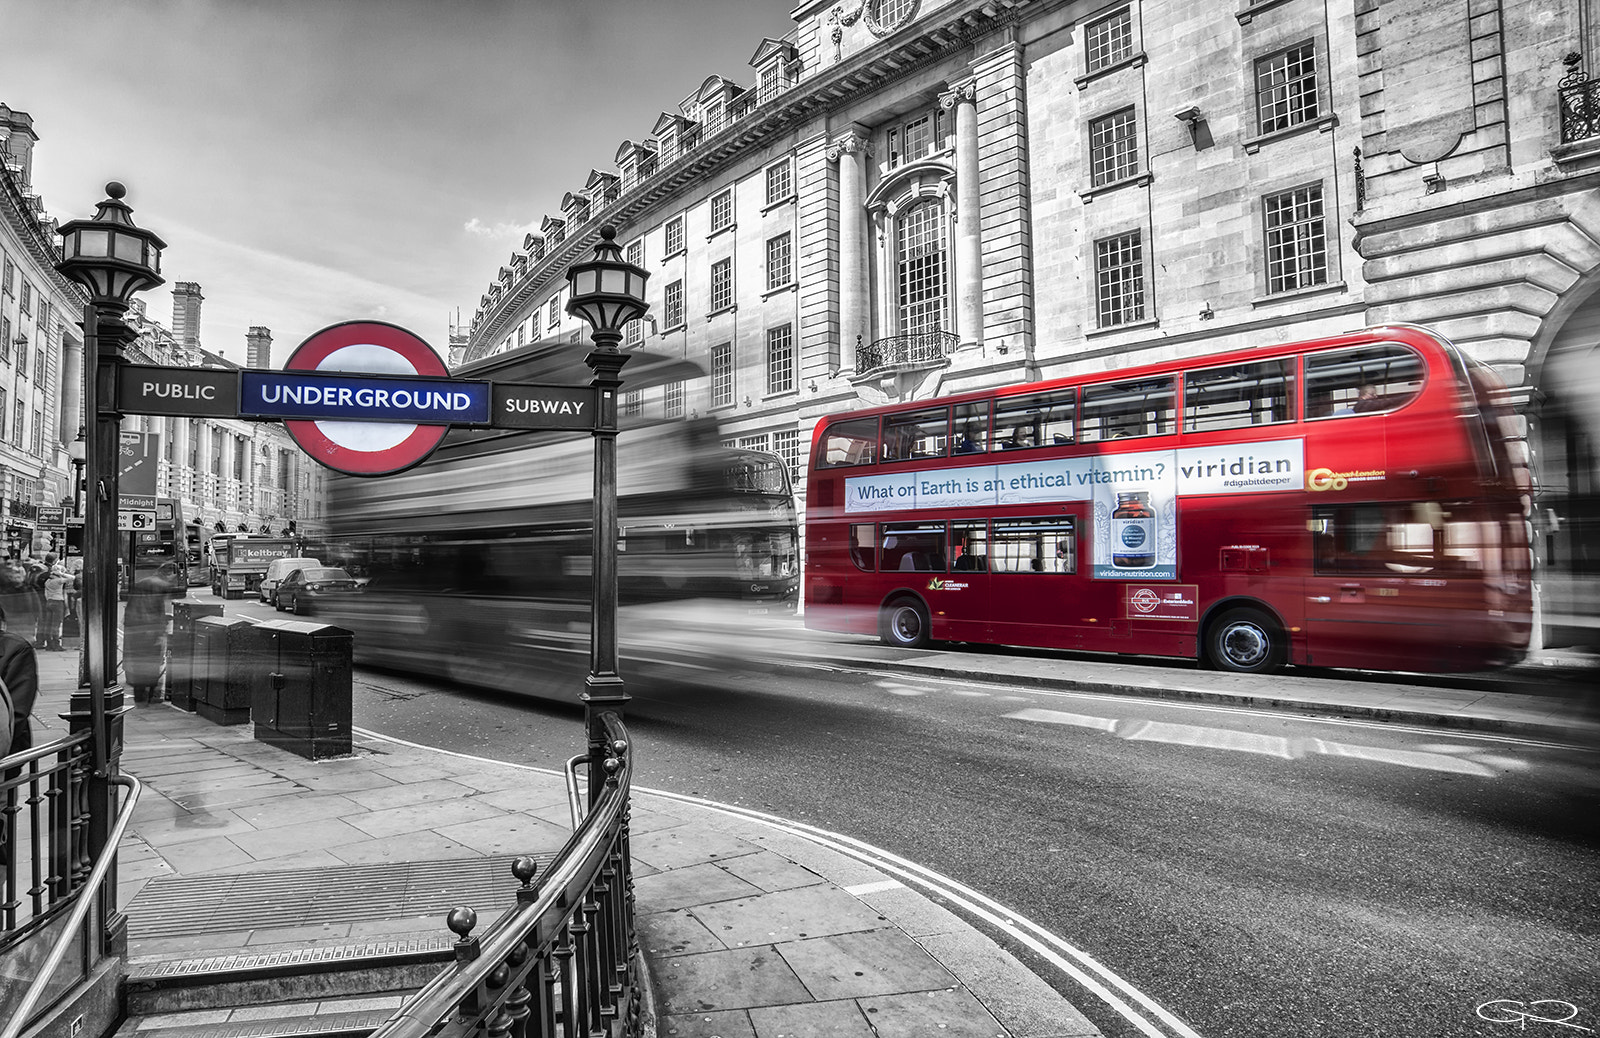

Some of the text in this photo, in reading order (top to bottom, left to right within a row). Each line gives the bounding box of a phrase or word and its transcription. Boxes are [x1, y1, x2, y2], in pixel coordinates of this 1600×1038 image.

[142, 381, 216, 400] PUBLIC
[261, 384, 471, 411] UNDERGROUND
[505, 398, 585, 415] SUBWAY
[1181, 456, 1292, 479] viridian
[857, 463, 1166, 500] What on Earth is an ethical vitamin?
[1223, 477, 1292, 488] #digabitdeeper
[1308, 468, 1348, 492] Go
[120, 499, 154, 507] Midnight
[247, 549, 288, 558] keltbray
